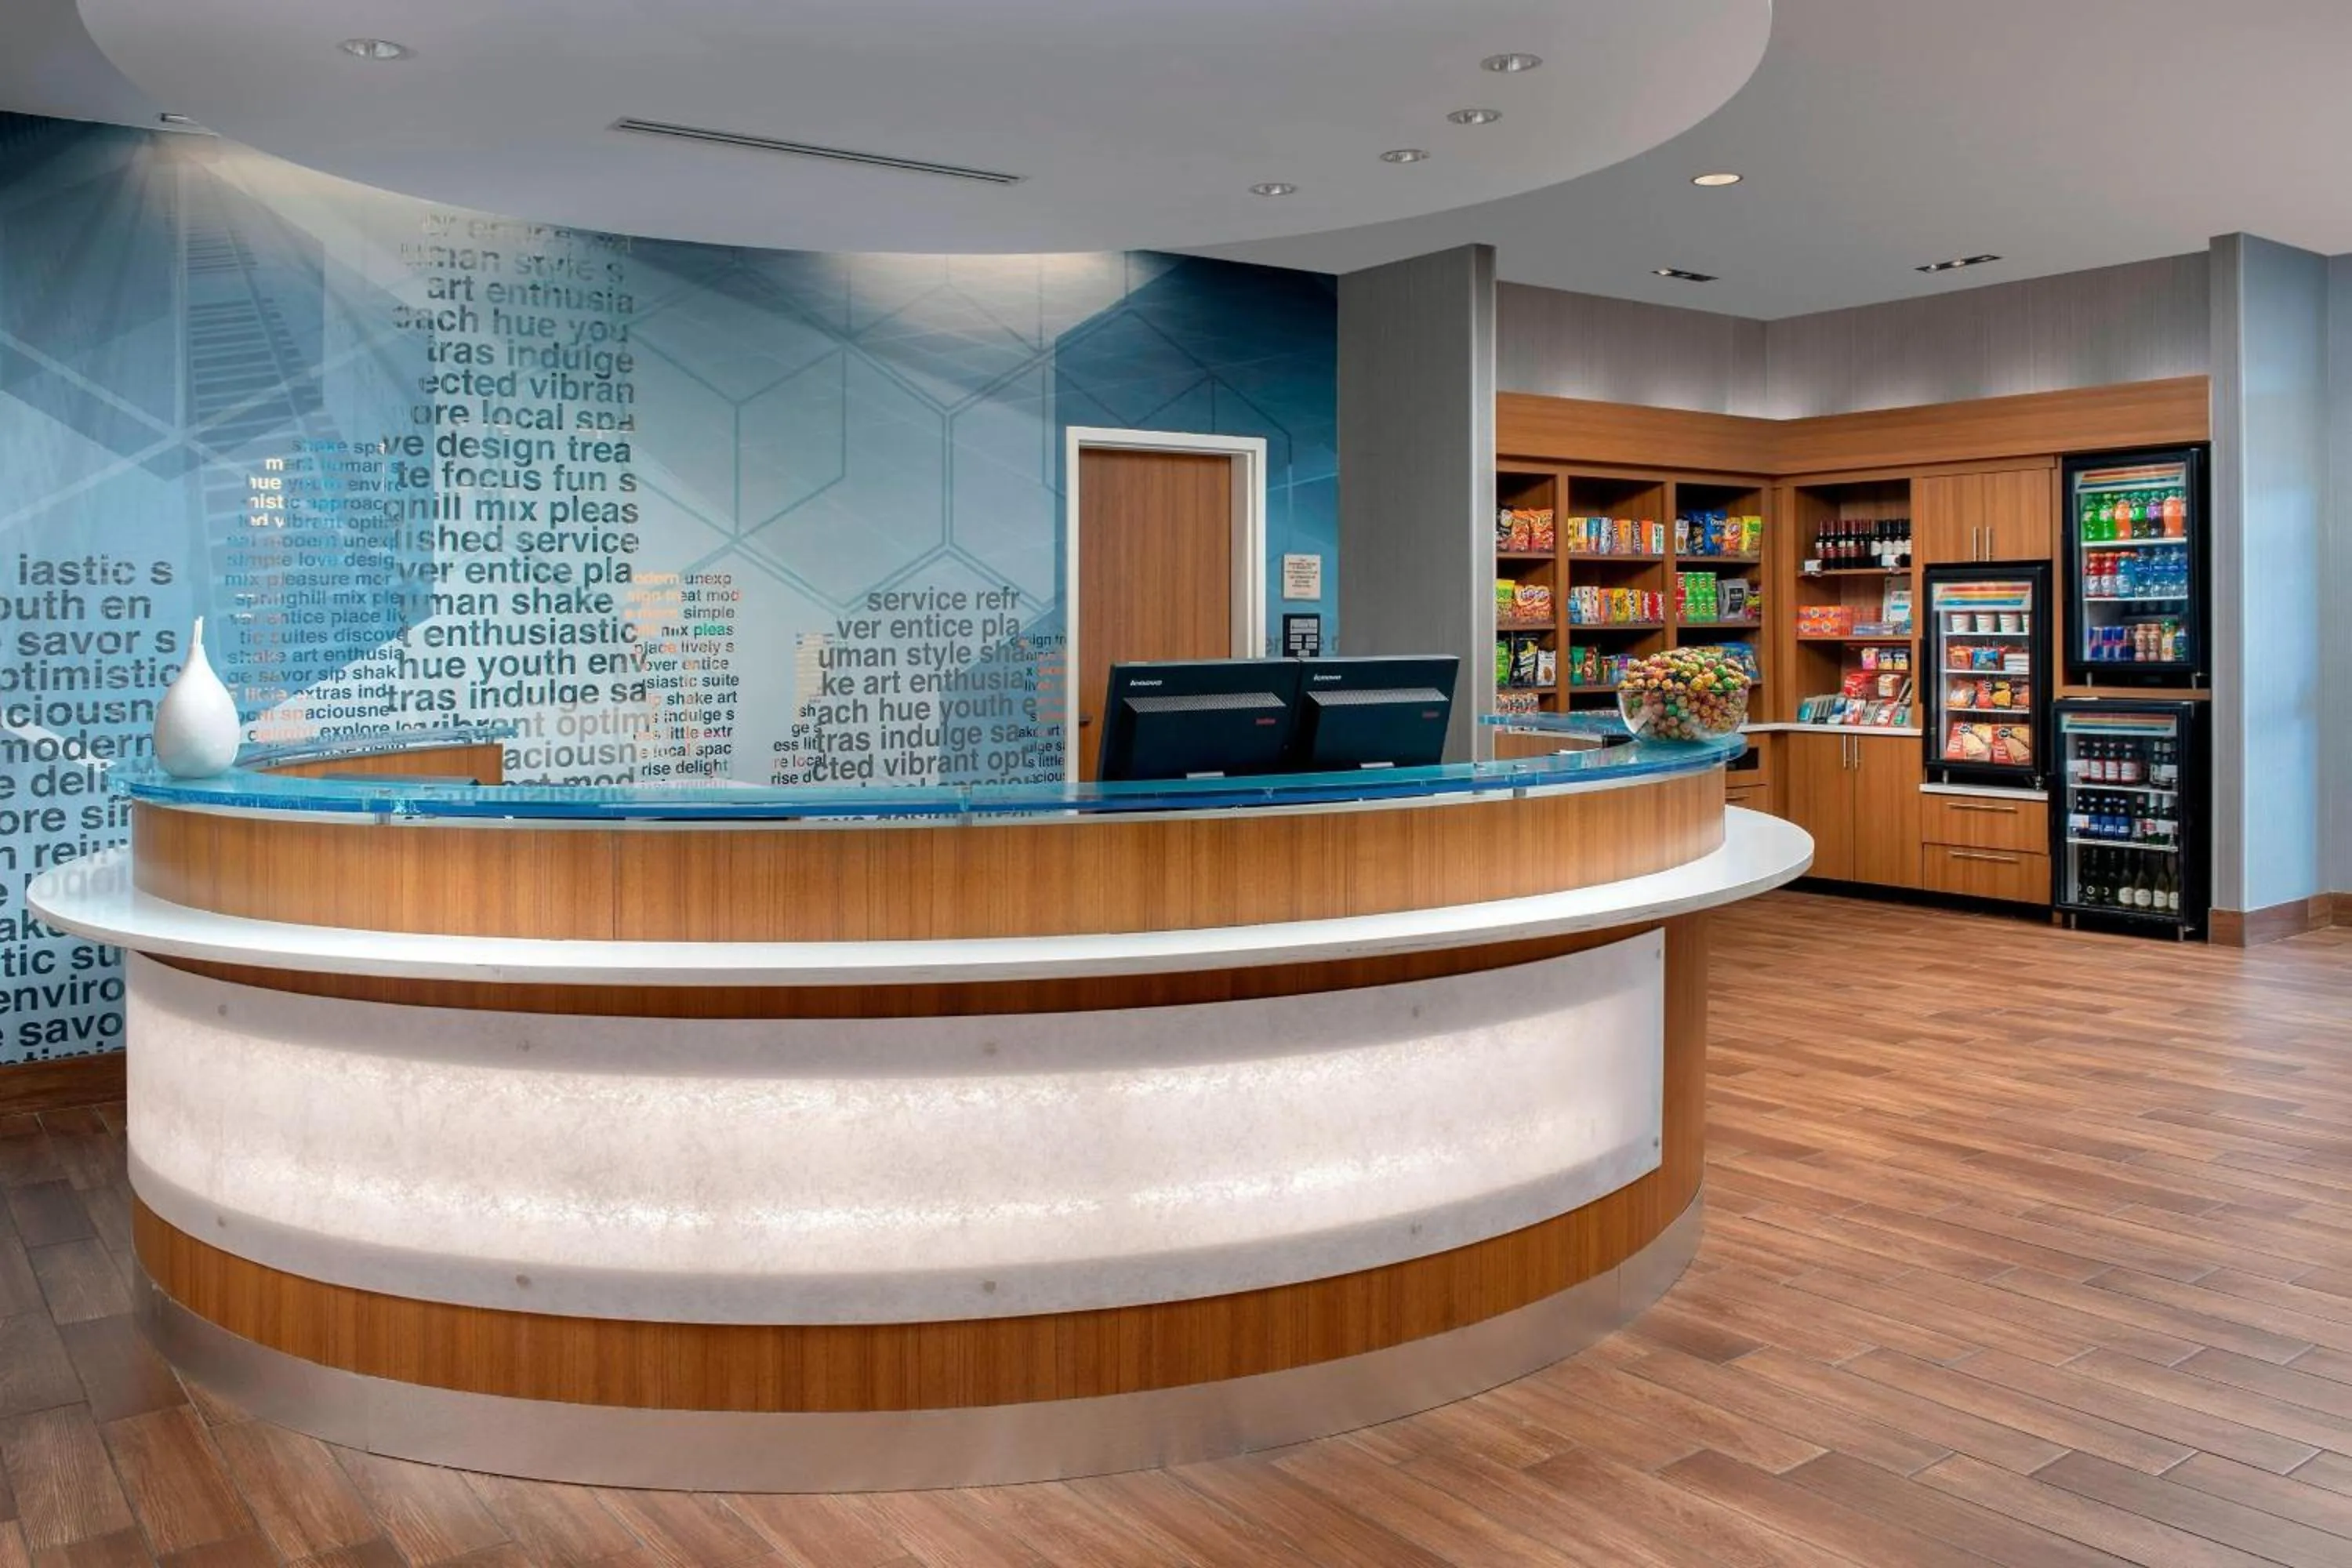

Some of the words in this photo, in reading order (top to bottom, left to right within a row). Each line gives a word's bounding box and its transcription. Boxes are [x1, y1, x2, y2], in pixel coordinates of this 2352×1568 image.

[427, 275, 475, 302] art
[486, 280, 633, 314] enthusia
[492, 307, 557, 338] hue
[568, 318, 628, 346] you
[507, 339, 634, 379] indulge
[529, 372, 634, 404] vibran
[481, 399, 564, 430] local
[436, 431, 556, 467] design
[568, 436, 632, 463] trea
[397, 460, 431, 488] te
[441, 460, 543, 492] focus
[552, 463, 607, 492] fun
[619, 471, 638, 492] s
[475, 498, 538, 522] mix
[550, 495, 640, 529] pleas
[516, 526, 640, 553] service
[18, 553, 136, 586] iastic
[150, 560, 173, 586] s
[266, 572, 350, 590] pleasure
[397, 560, 455, 583] ver
[465, 556, 573, 583] entice
[583, 557, 633, 588] pla
[100, 593, 152, 620] en
[333, 591, 367, 606] mix
[511, 587, 614, 615] shake
[683, 604, 735, 621] simple
[866, 586, 967, 612] service
[975, 586, 1021, 611] refr
[424, 617, 638, 648] enthusiastic
[693, 622, 735, 641] pleas
[836, 619, 882, 641] ver
[889, 614, 974, 640] entice
[982, 612, 1021, 643] pla
[16, 629, 141, 657] savor
[154, 630, 176, 654] s
[292, 649, 318, 663] art
[323, 646, 404, 662] enthusia
[724, 641, 735, 654] s
[818, 646, 897, 670] uman
[906, 644, 972, 672] style
[979, 639, 1027, 666] sha
[352, 664, 397, 681] shak
[397, 650, 466, 681] hue
[477, 648, 576, 684] youth
[587, 652, 647, 676] env
[681, 656, 730, 671] entice
[701, 673, 740, 688] suite
[822, 669, 855, 698] ke
[862, 671, 902, 695] art
[909, 668, 1025, 694] enthusia
[388, 684, 457, 713] tras
[470, 679, 600, 713] indulge
[610, 681, 648, 704] sa
[666, 691, 713, 706] shake
[717, 690, 739, 704] art
[799, 704, 816, 717] sh
[817, 698, 869, 726] ach
[878, 697, 931, 722] hue
[939, 693, 1011, 726] youth
[556, 708, 648, 743] optim
[664, 708, 722, 725] indulge
[725, 709, 735, 721] s
[791, 722, 810, 738] ge
[702, 724, 734, 739] extr
[774, 739, 799, 752] ess
[815, 728, 871, 754] tras
[880, 722, 983, 753] indulge
[989, 723, 1022, 743] sa
[503, 742, 637, 771] aciousn
[695, 742, 732, 758] spac
[812, 753, 874, 782] cted
[883, 747, 980, 778] vibrant
[987, 748, 1029, 775] opt
[641, 761, 672, 776] rise
[674, 757, 729, 776] delight
[771, 771, 799, 785] rise
[1, 945, 56, 978] tic
[0, 975, 126, 1014] enviro
[19, 1011, 124, 1047] savo
